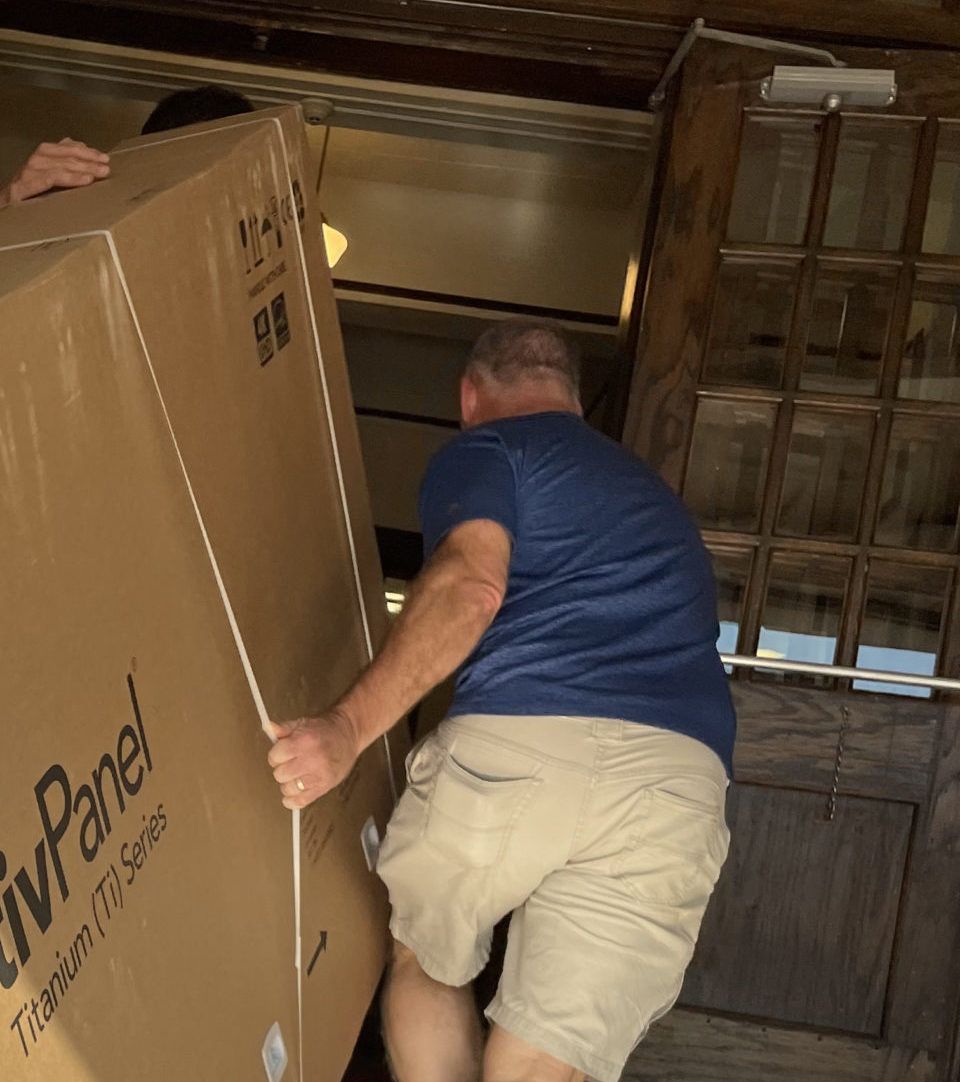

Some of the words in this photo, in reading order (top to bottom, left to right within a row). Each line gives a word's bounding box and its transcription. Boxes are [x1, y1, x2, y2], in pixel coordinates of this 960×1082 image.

[10, 923, 94, 1058] Titanium
[91, 863, 123, 939] (Ti)
[120, 803, 168, 886] Series
